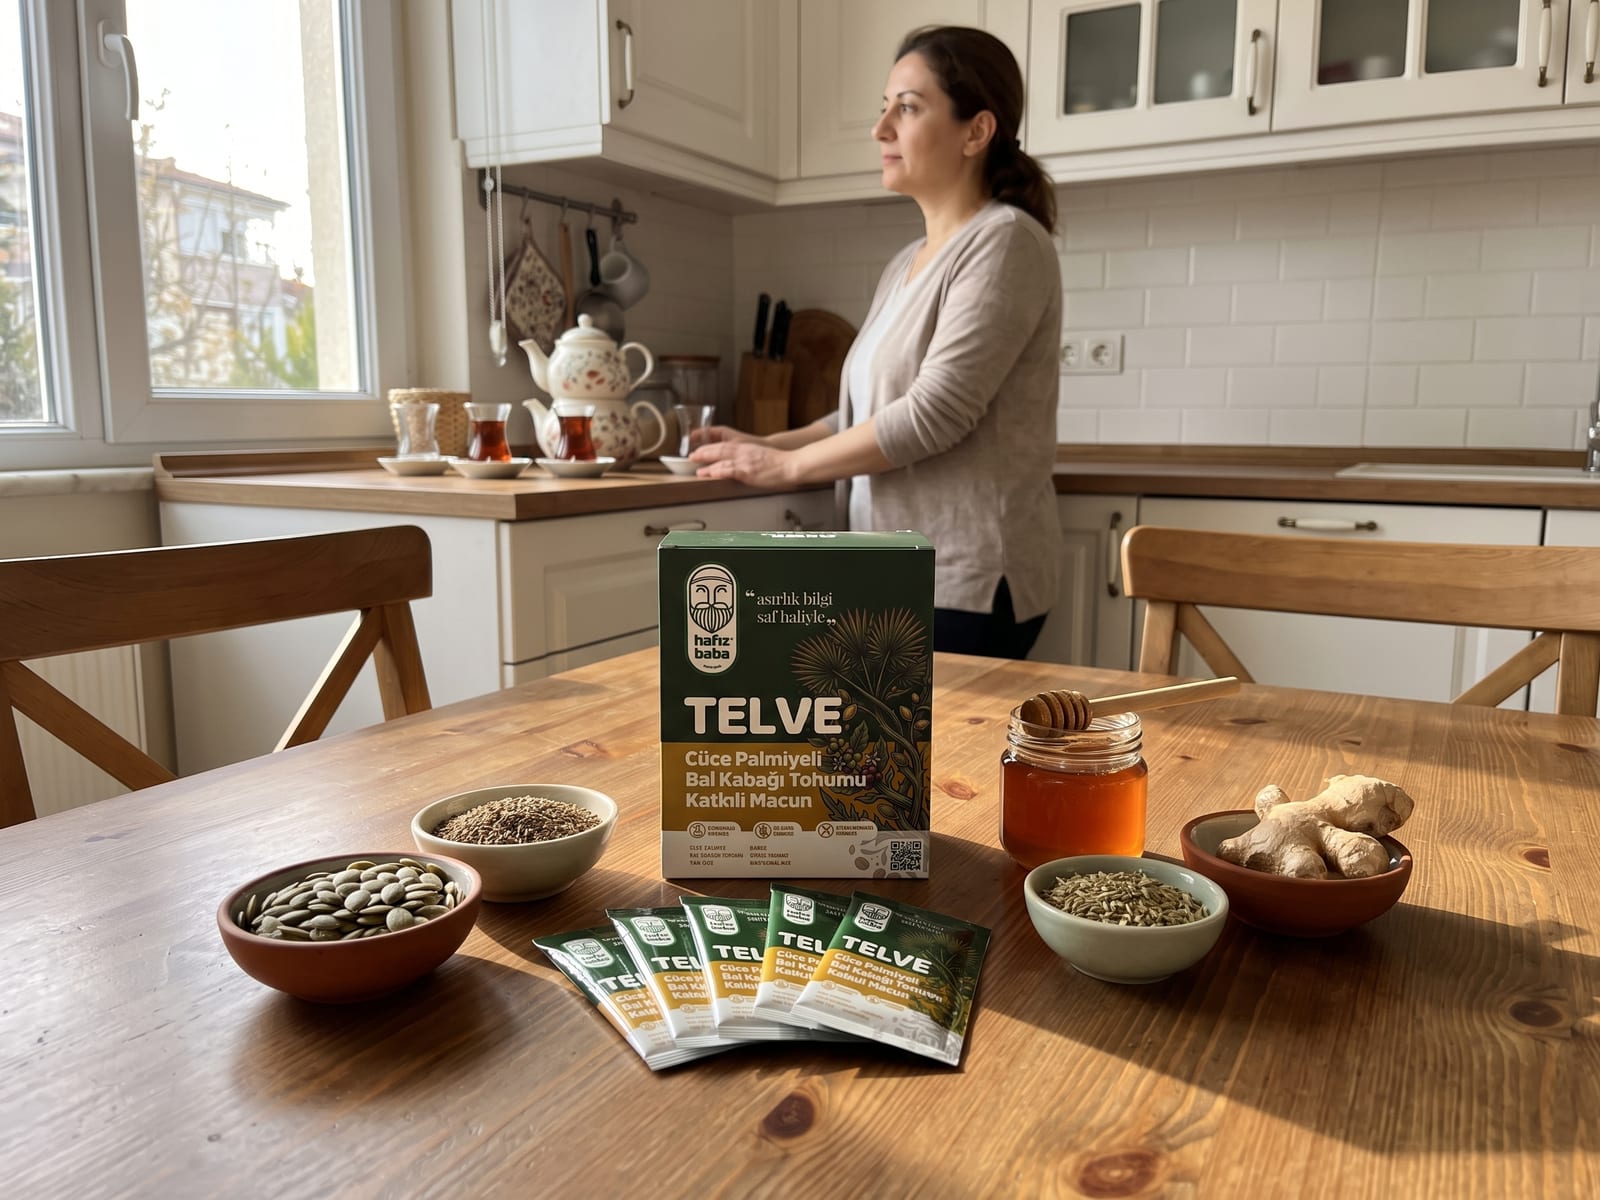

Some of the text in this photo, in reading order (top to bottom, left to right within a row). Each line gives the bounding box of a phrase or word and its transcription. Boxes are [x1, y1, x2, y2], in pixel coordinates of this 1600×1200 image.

[803, 591, 833, 608] bilgi
[757, 609, 778, 624] saf
[694, 647, 730, 659] baba
[683, 696, 843, 735] TELVE
[684, 750, 822, 770] Cüce Palmiyeli
[685, 771, 867, 791] Bal Kabağı Tohumu
[750, 793, 813, 809] Macun
[842, 935, 933, 975] TELVE
